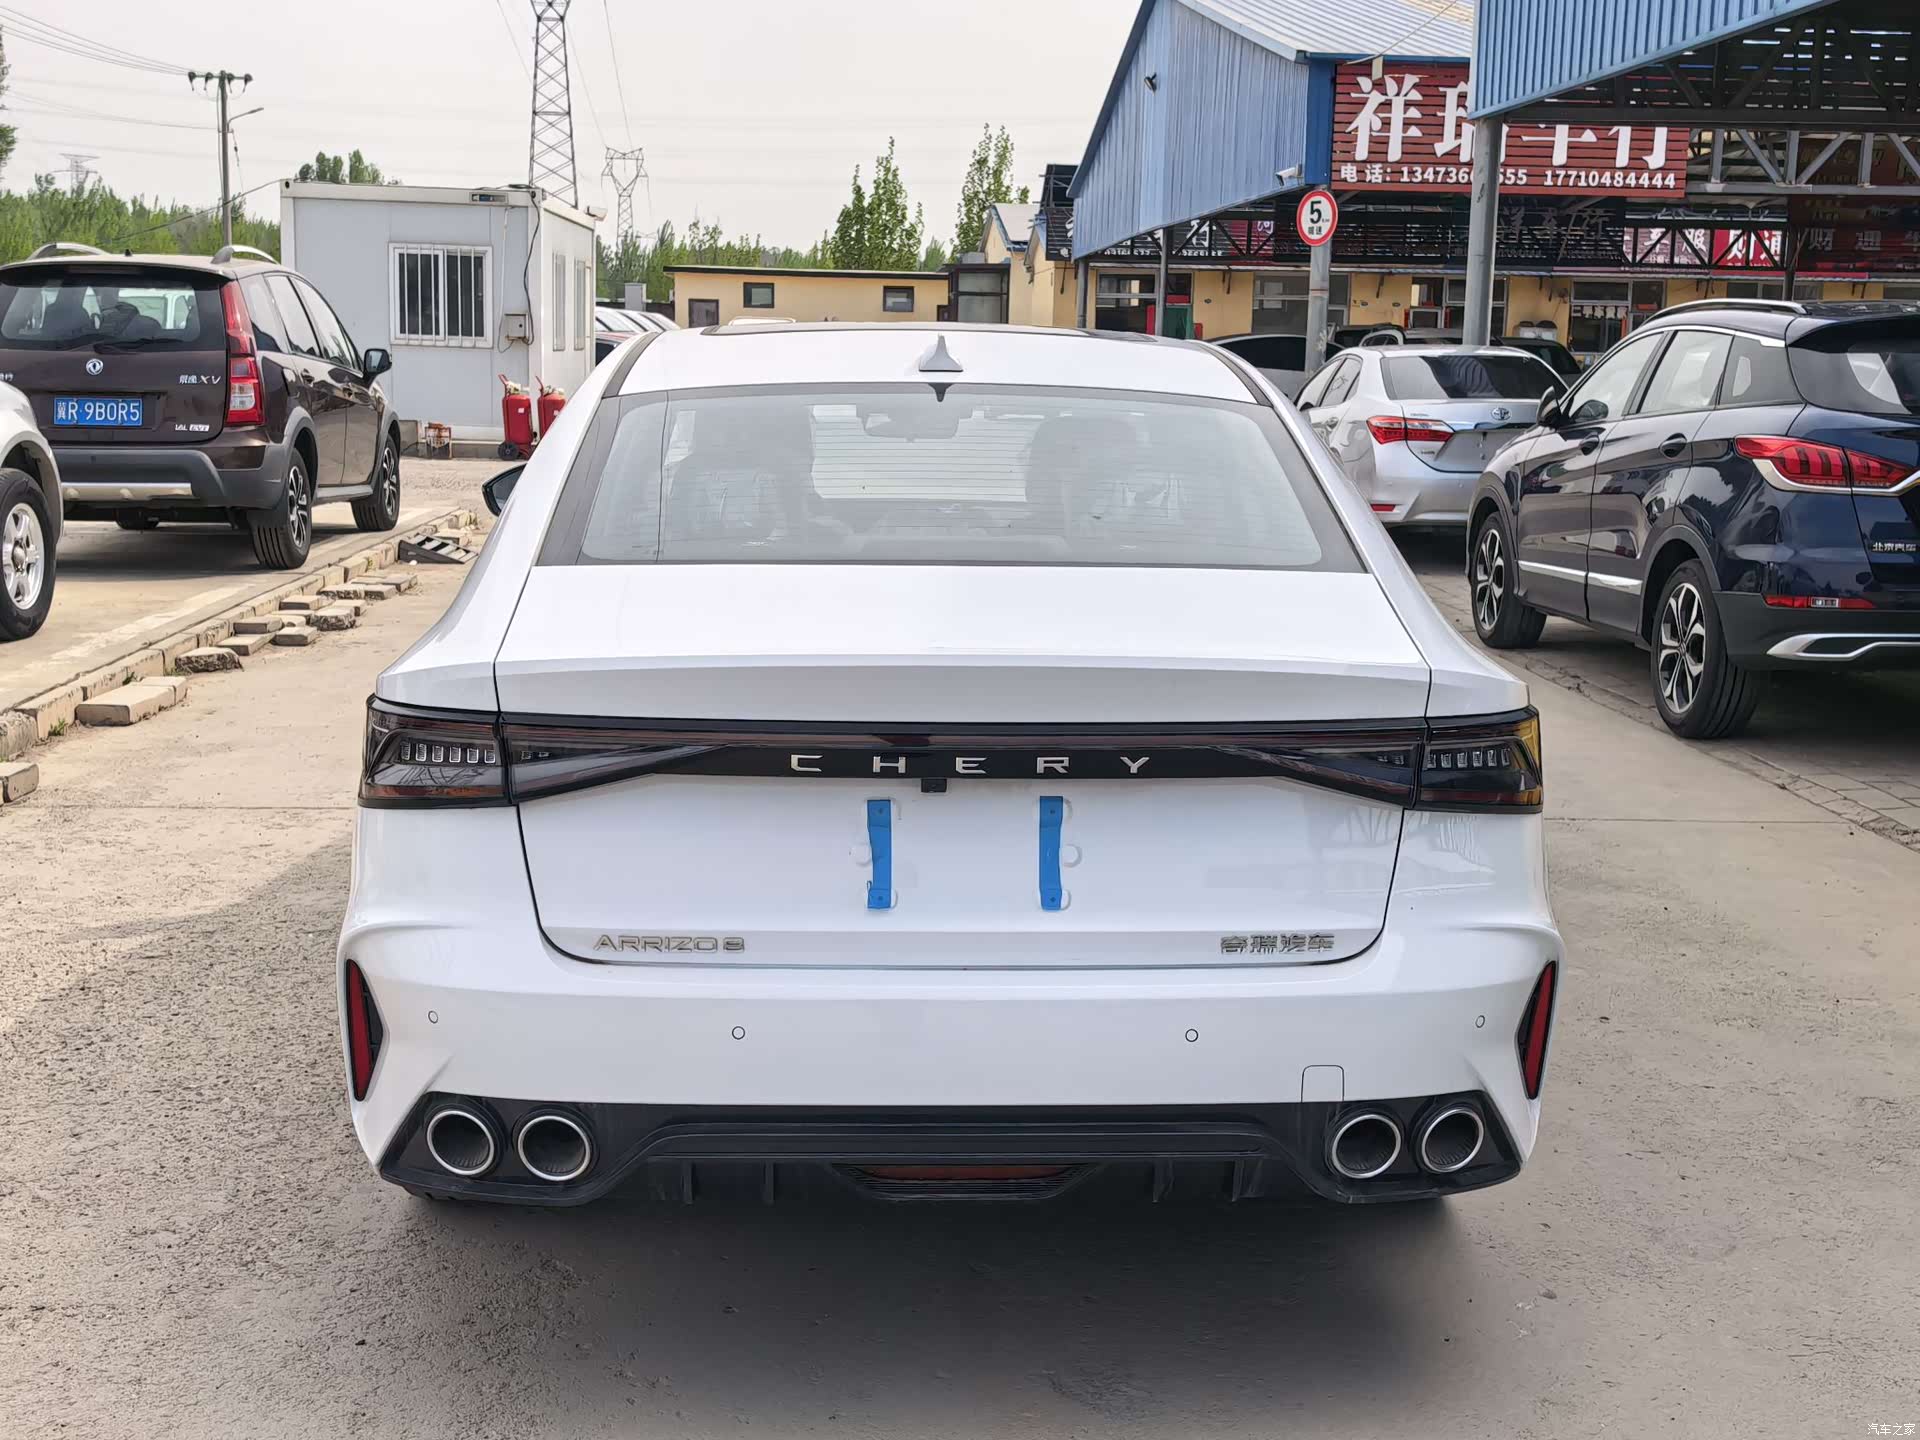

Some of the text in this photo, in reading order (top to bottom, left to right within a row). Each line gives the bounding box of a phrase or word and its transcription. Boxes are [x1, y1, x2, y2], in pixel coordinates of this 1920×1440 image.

[1400, 166, 1528, 185] 13473655
[1543, 170, 1676, 189] 17710484444
[1310, 200, 1322, 224] 5
[790, 753, 1150, 774] CHERY
[593, 934, 745, 954] ARRIZO 8
[1220, 932, 1335, 954] 奇瑞汽车
